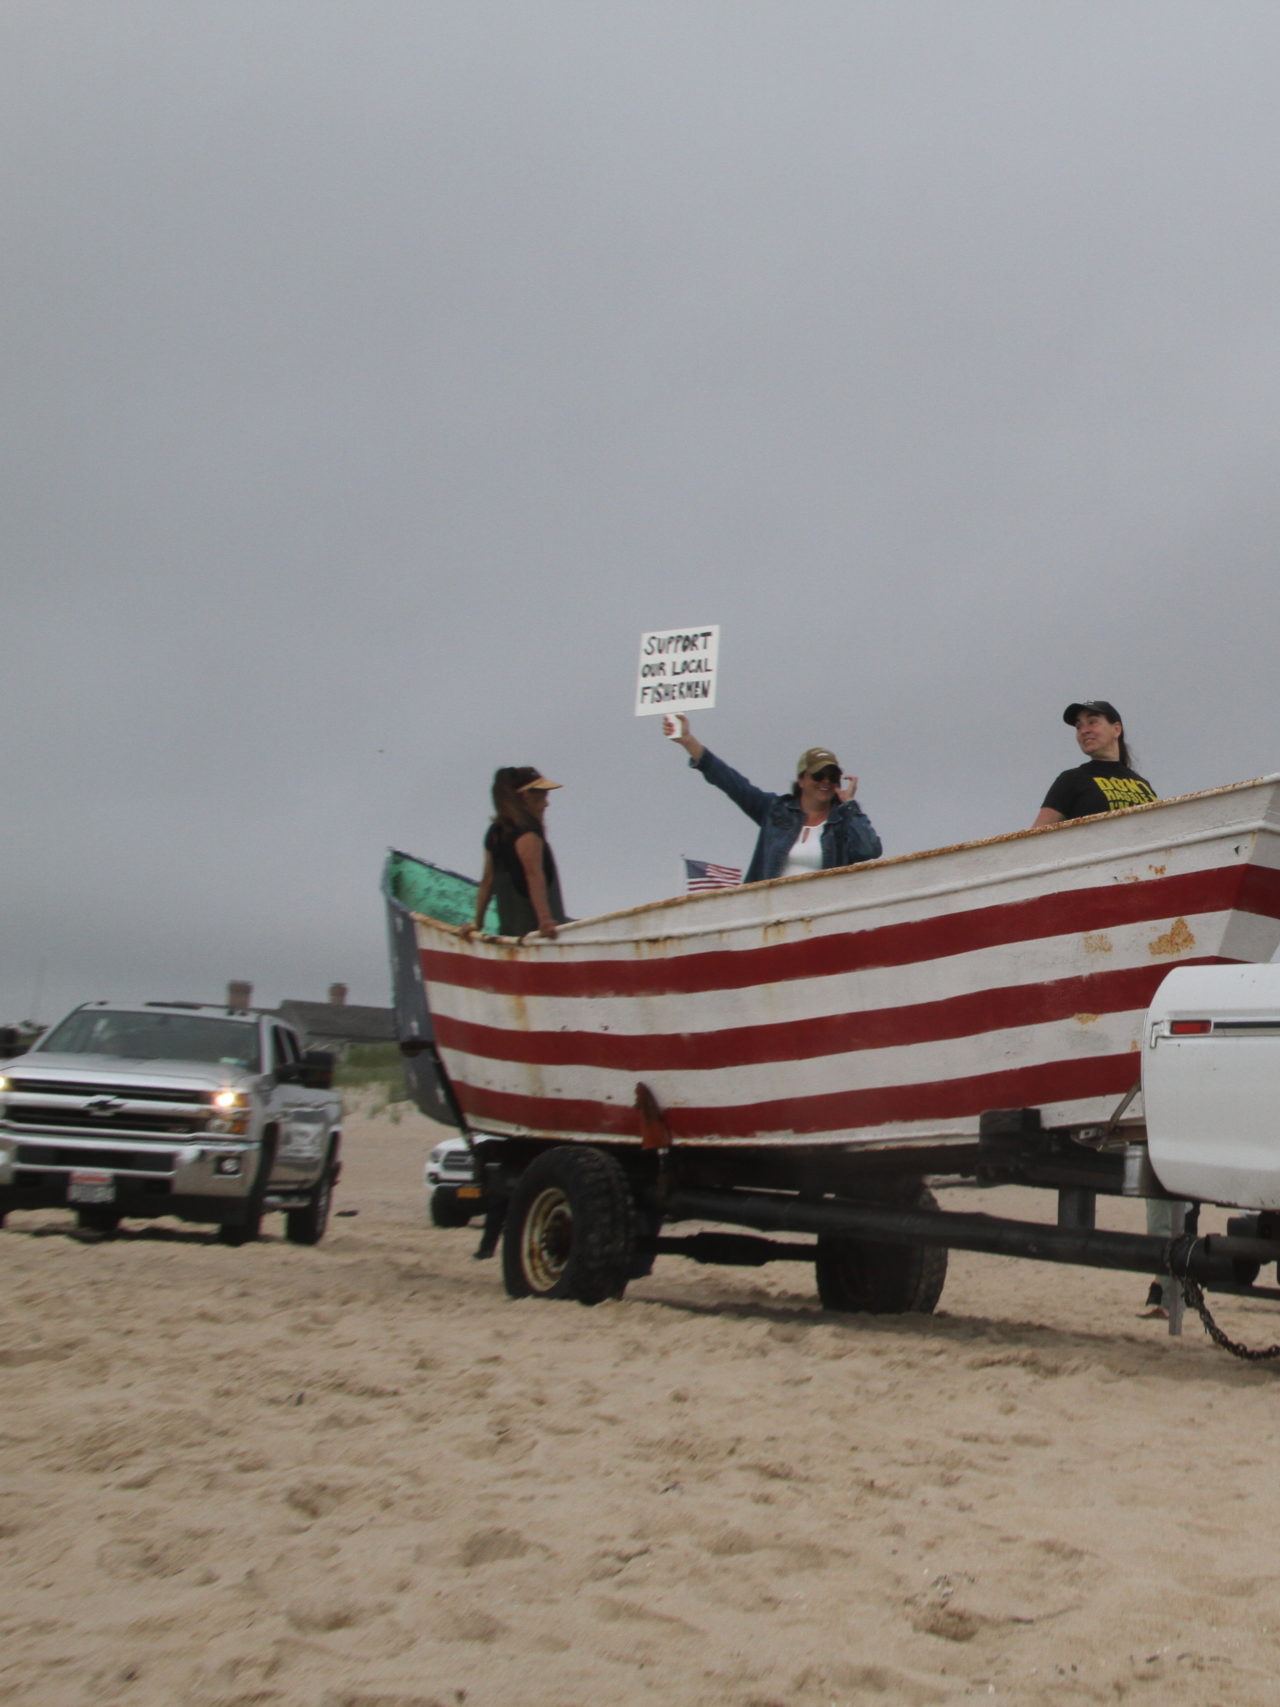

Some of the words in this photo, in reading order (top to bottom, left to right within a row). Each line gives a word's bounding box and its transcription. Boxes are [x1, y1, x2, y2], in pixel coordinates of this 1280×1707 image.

[644, 631, 712, 656] SUPPORT
[641, 661, 667, 678] OUR
[671, 658, 713, 676] LOCAL
[640, 680, 711, 704] FISHERMEN
